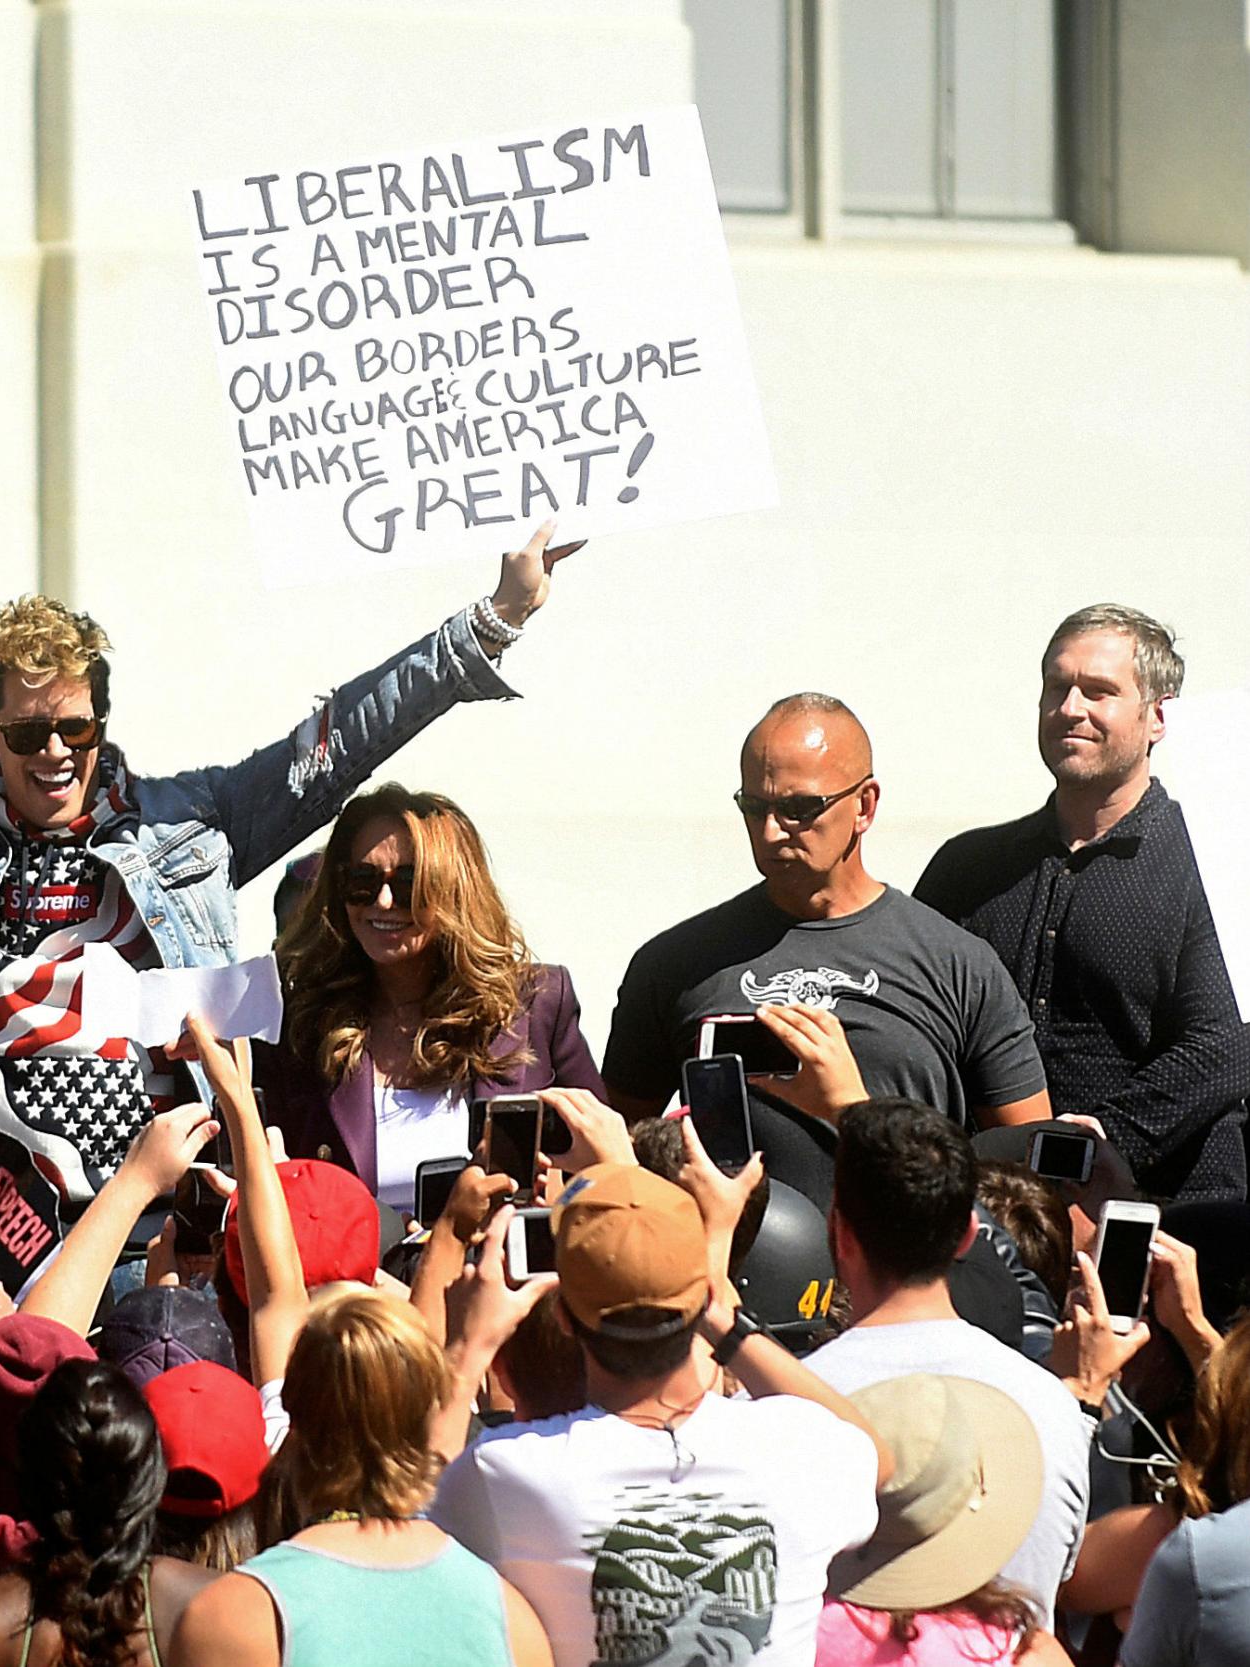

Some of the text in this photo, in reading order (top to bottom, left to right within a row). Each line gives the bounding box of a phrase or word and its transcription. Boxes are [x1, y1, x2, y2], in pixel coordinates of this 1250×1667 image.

[193, 124, 650, 240] LIBERALISM
[203, 199, 589, 295] IS A MENTAL
[217, 257, 535, 345] DISORDER
[228, 307, 581, 414] OUR BORDERS
[238, 378, 448, 452] LANGUAGE
[475, 338, 701, 406] CULTURE
[243, 392, 647, 496] MAKE AMERICA
[343, 433, 655, 553] GREAT!
